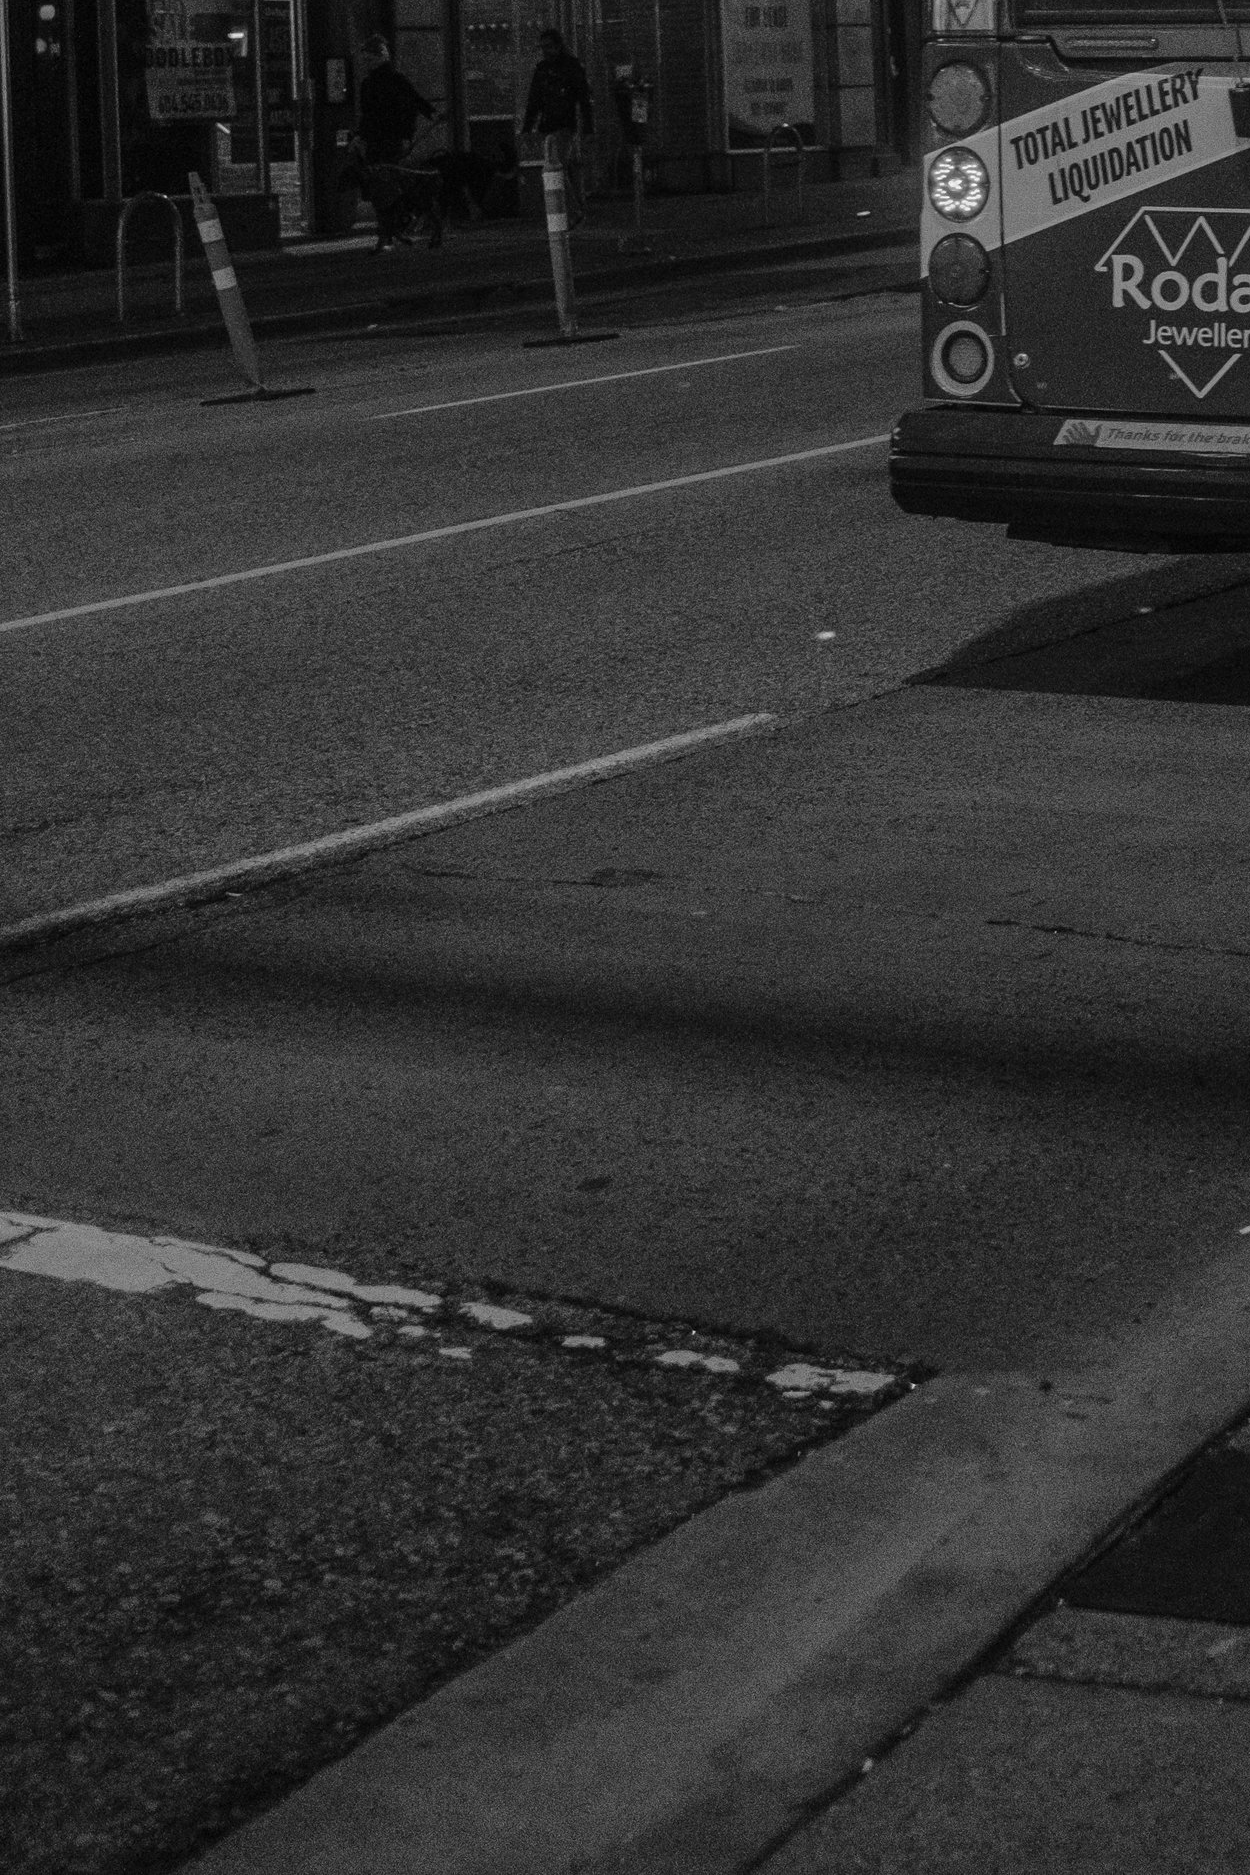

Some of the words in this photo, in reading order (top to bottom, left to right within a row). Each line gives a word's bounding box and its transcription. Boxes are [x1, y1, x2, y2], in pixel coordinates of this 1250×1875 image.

[1009, 116, 1078, 170] TOTAL
[1081, 67, 1204, 145] JEWELLERY
[1048, 119, 1193, 205] LIQUIDATION
[1107, 428, 1161, 442] Thanks
[1163, 429, 1186, 444] for
[1187, 430, 1214, 444] the
